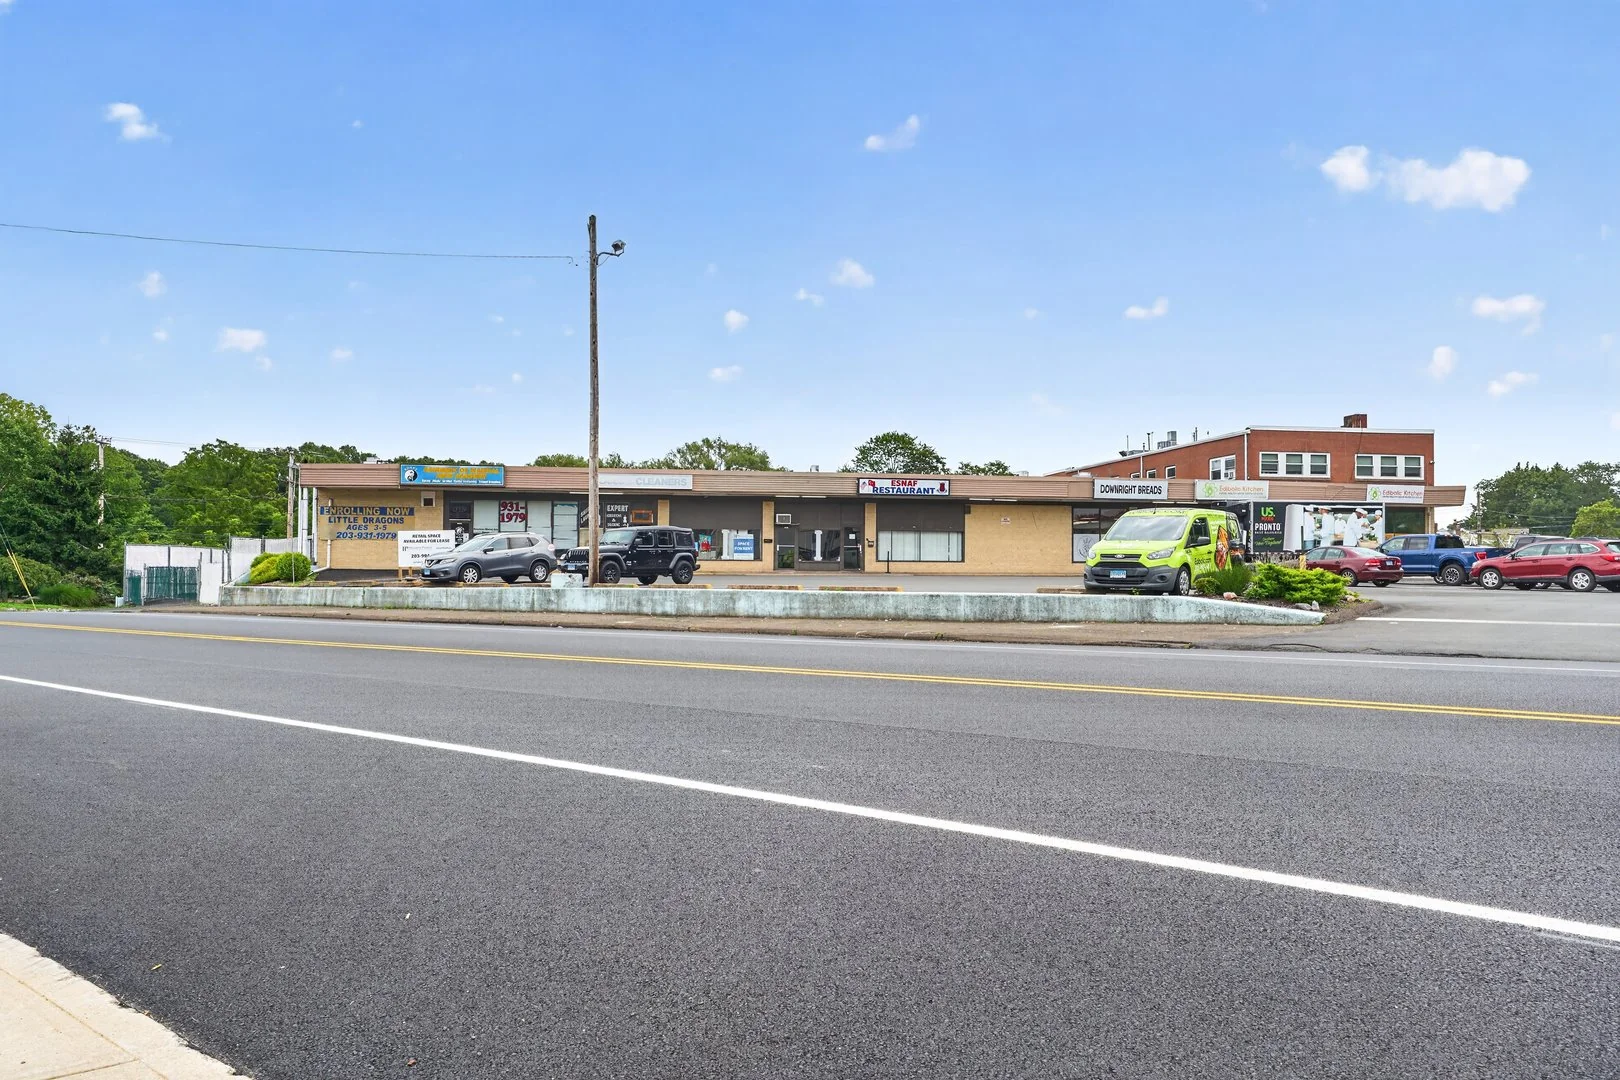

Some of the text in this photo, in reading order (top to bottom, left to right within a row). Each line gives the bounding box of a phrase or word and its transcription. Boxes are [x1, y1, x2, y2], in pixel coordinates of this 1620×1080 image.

[635, 477, 688, 486] CLEANERS
[1100, 484, 1163, 495] DOWNRIGHT BREADS
[324, 506, 410, 516] ENROLLING NOW
[500, 501, 526, 512] 931-
[607, 504, 629, 512] EXPERT
[328, 516, 405, 524] LITTLE DRAGONS
[500, 512, 528, 523] 1979
[1254, 522, 1281, 531] PRONTO
[336, 531, 397, 540] 203-931-1979
